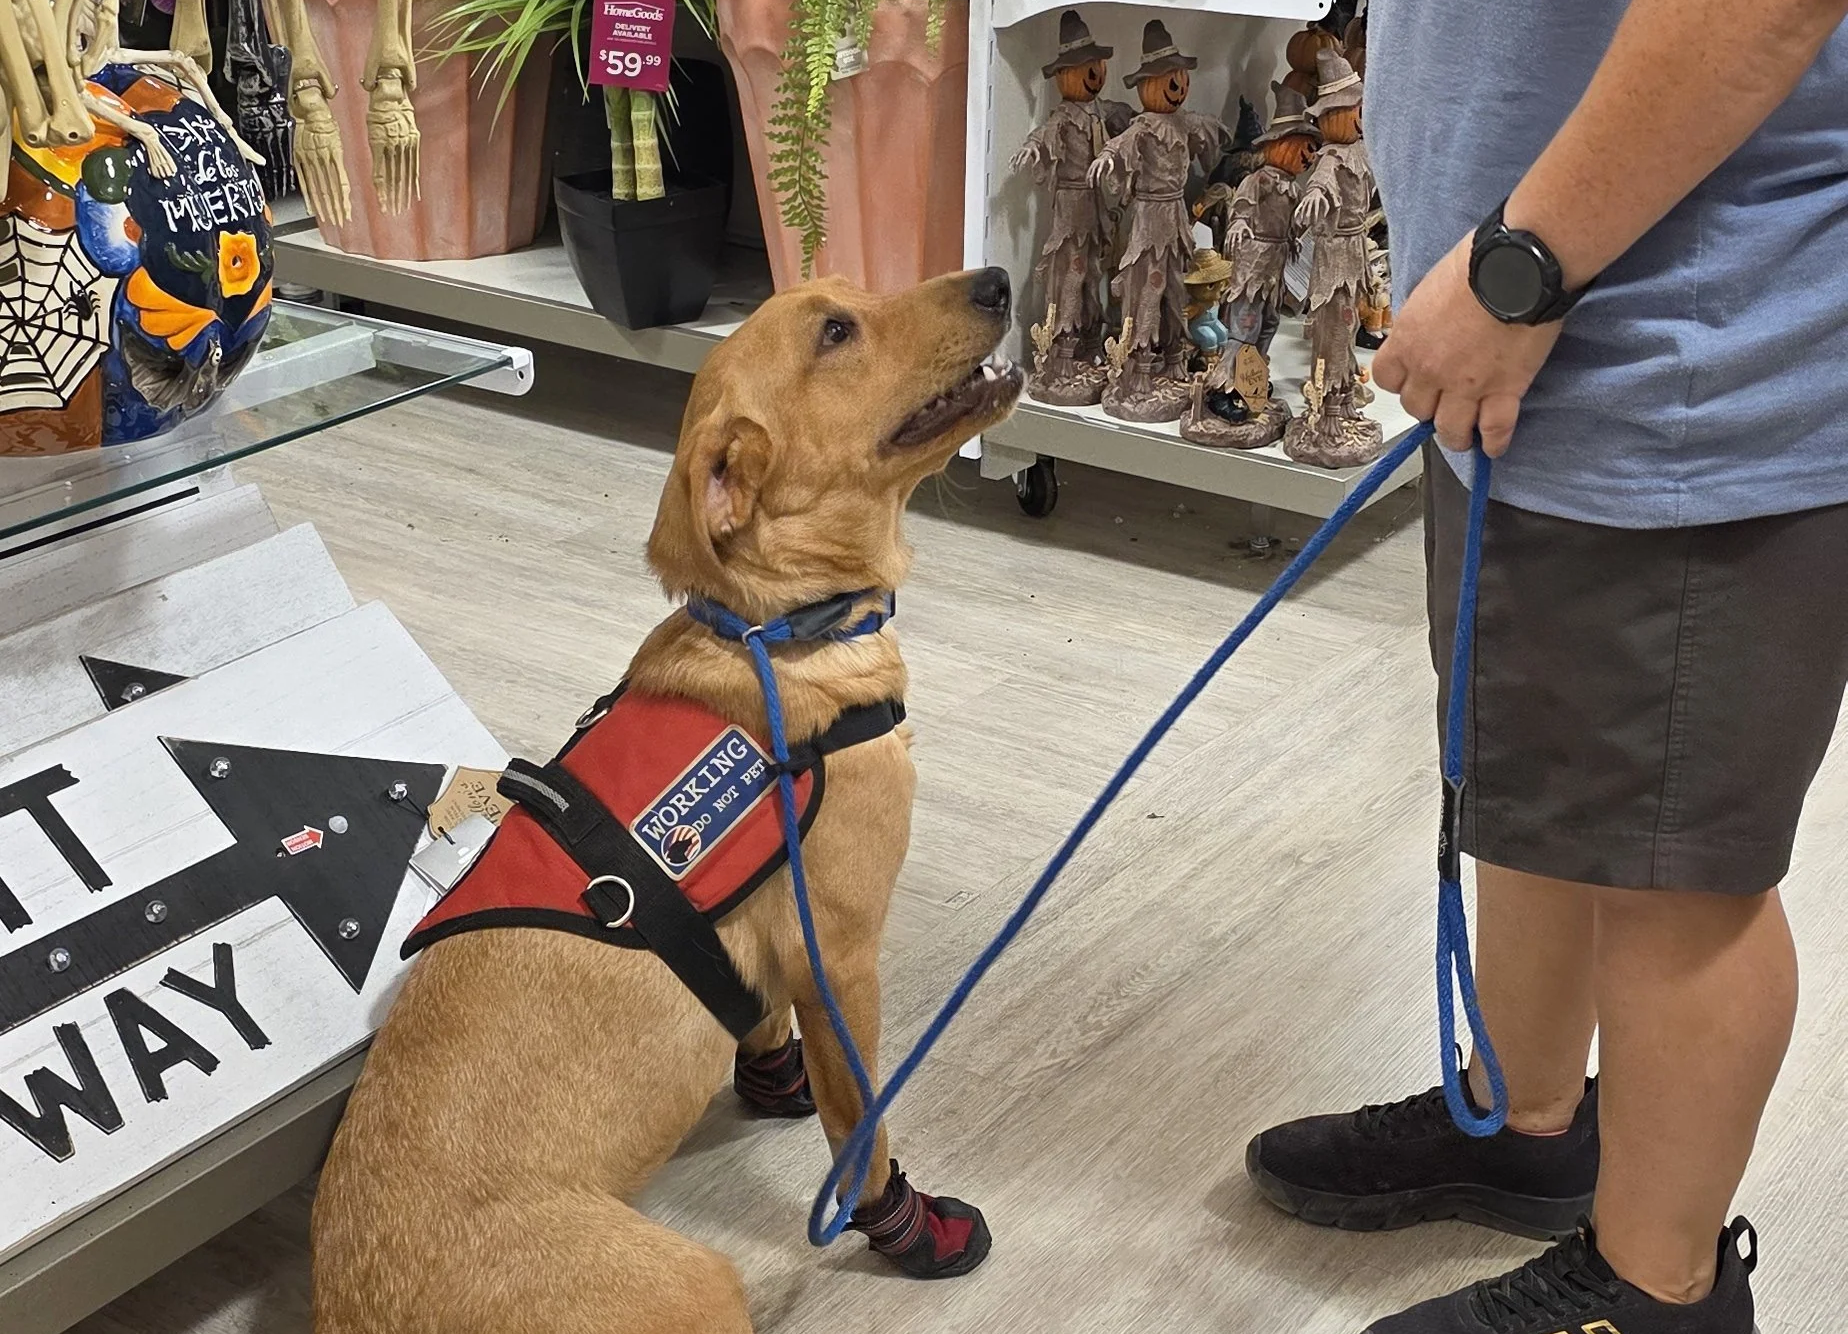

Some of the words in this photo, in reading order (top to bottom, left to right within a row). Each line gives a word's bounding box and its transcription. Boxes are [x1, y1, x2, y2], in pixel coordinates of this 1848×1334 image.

[603, 4, 664, 22] HomeGoods
[614, 22, 652, 33] DELIVERY
[612, 29, 653, 41] AVAILABLE
[599, 49, 662, 78] $59.99
[194, 150, 217, 185] de
[158, 177, 265, 233] MUERTO
[471, 781, 502, 818] EVE
[641, 737, 748, 841] WORKING
[692, 813, 712, 833] DO
[712, 785, 740, 813] NOT
[739, 758, 766, 786] PET
[0, 943, 273, 1163] WAY
